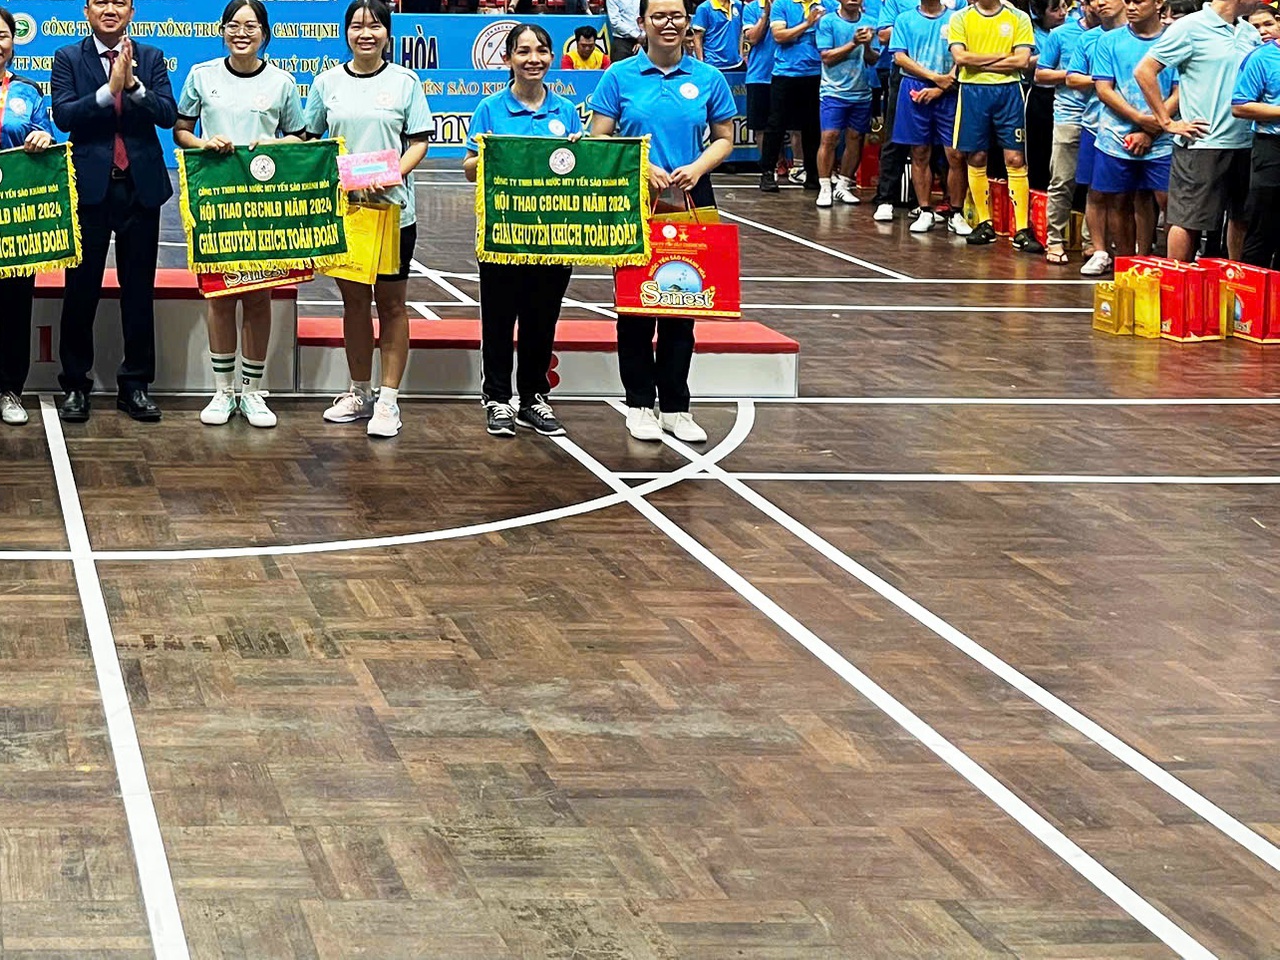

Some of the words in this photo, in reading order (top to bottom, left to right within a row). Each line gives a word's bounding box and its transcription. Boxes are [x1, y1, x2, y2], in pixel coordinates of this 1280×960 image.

[42, 17, 75, 36] CÔNG
[131, 21, 156, 37] MTV
[157, 18, 191, 37] NÔNG
[273, 23, 299, 38] CAM
[301, 23, 339, 41] THỊNH
[447, 78, 479, 95] SÀO
[13, 203, 36, 223] NĂM
[38, 201, 62, 219] 2024
[200, 201, 216, 224] HỘI
[217, 202, 242, 220] THAO
[244, 201, 282, 218] CBCNLĐ
[284, 197, 308, 216] NĂM
[310, 197, 332, 214] 2024
[512, 195, 537, 212] THAO
[539, 195, 580, 212] CBCNLĐ
[583, 193, 607, 212] NĂM
[608, 195, 631, 212] 2024
[640, 280, 716, 309] Sanest
